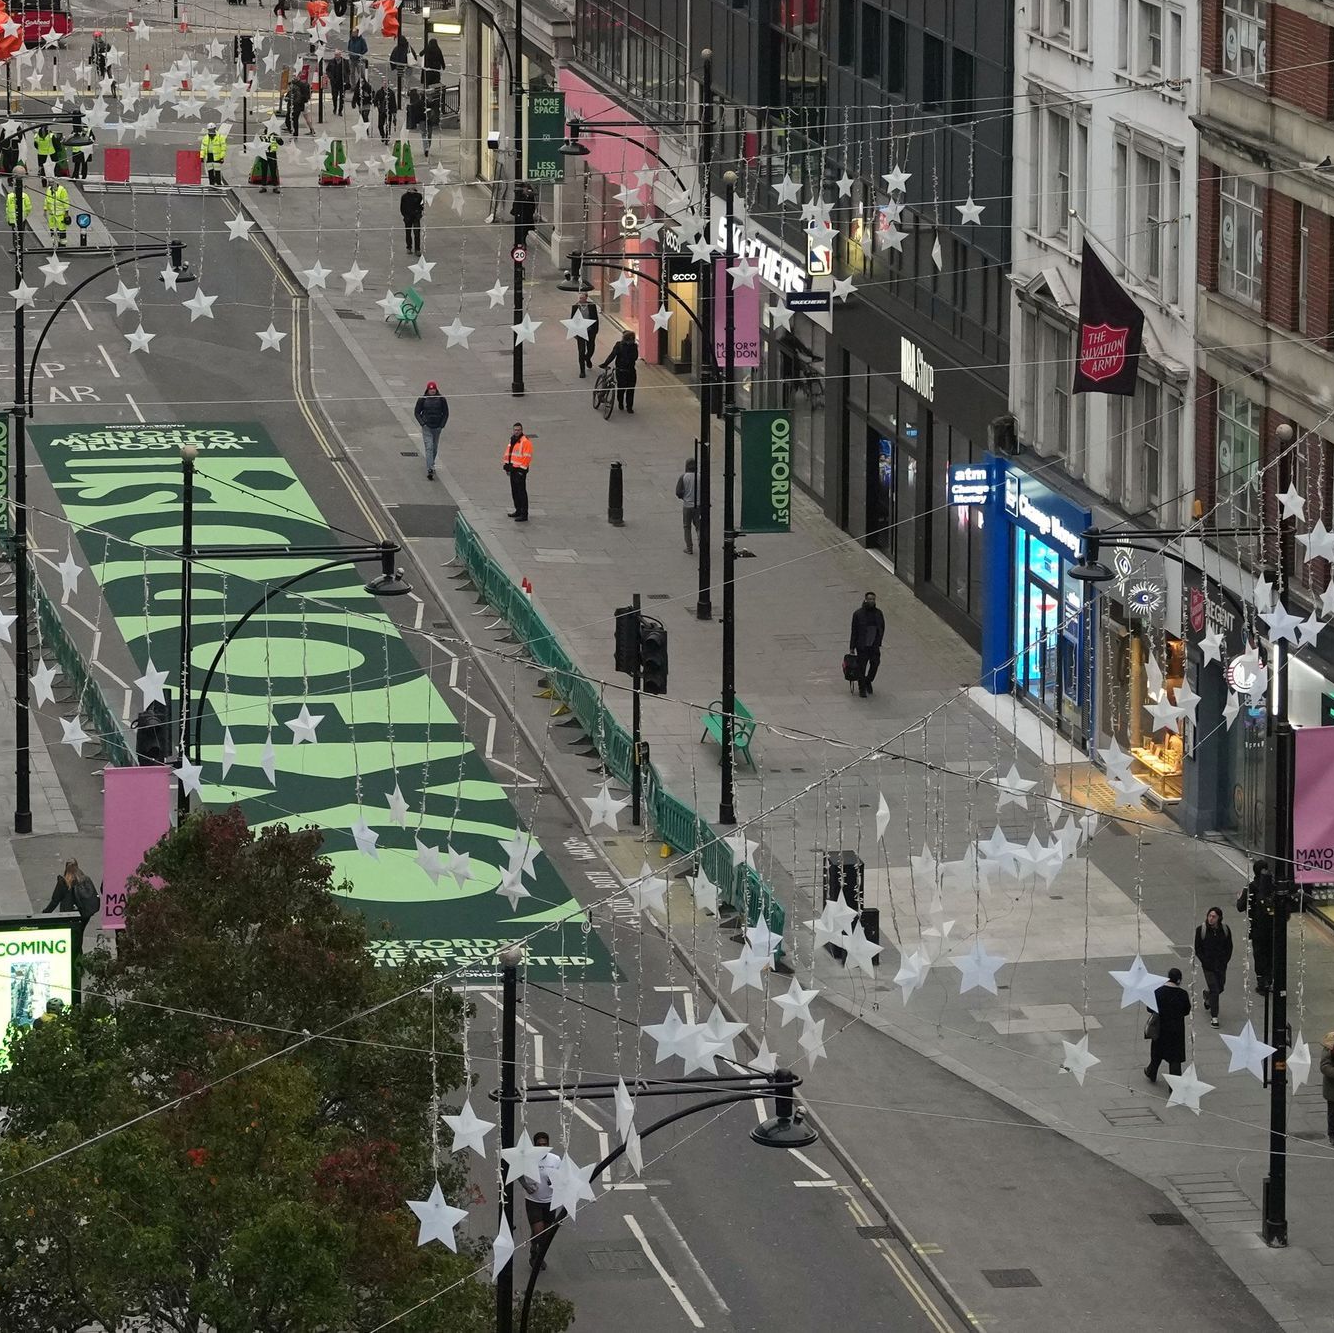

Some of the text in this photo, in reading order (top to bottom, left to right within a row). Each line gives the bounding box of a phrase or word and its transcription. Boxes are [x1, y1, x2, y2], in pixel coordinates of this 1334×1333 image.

[534, 98, 559, 106] MORE
[534, 106, 559, 114] SPACE
[537, 162, 555, 170] LESS
[529, 170, 564, 178] TRAFFIC
[672, 273, 697, 281] ecco
[1089, 330, 1107, 344] THE
[1081, 336, 1124, 364] SALVATION
[1091, 352, 1119, 373] ARMY
[90, 430, 235, 438] OXFORD
[49, 436, 259, 446] TO THE NEW
[69, 442, 243, 452] WELCOME
[771, 418, 790, 508] OXFORD
[955, 468, 987, 481] atm
[951, 484, 989, 495] Change
[953, 494, 987, 504] Money
[1019, 494, 1081, 558] Change Money
[563, 839, 597, 860] WAYS
[585, 872, 620, 888] BOTH
